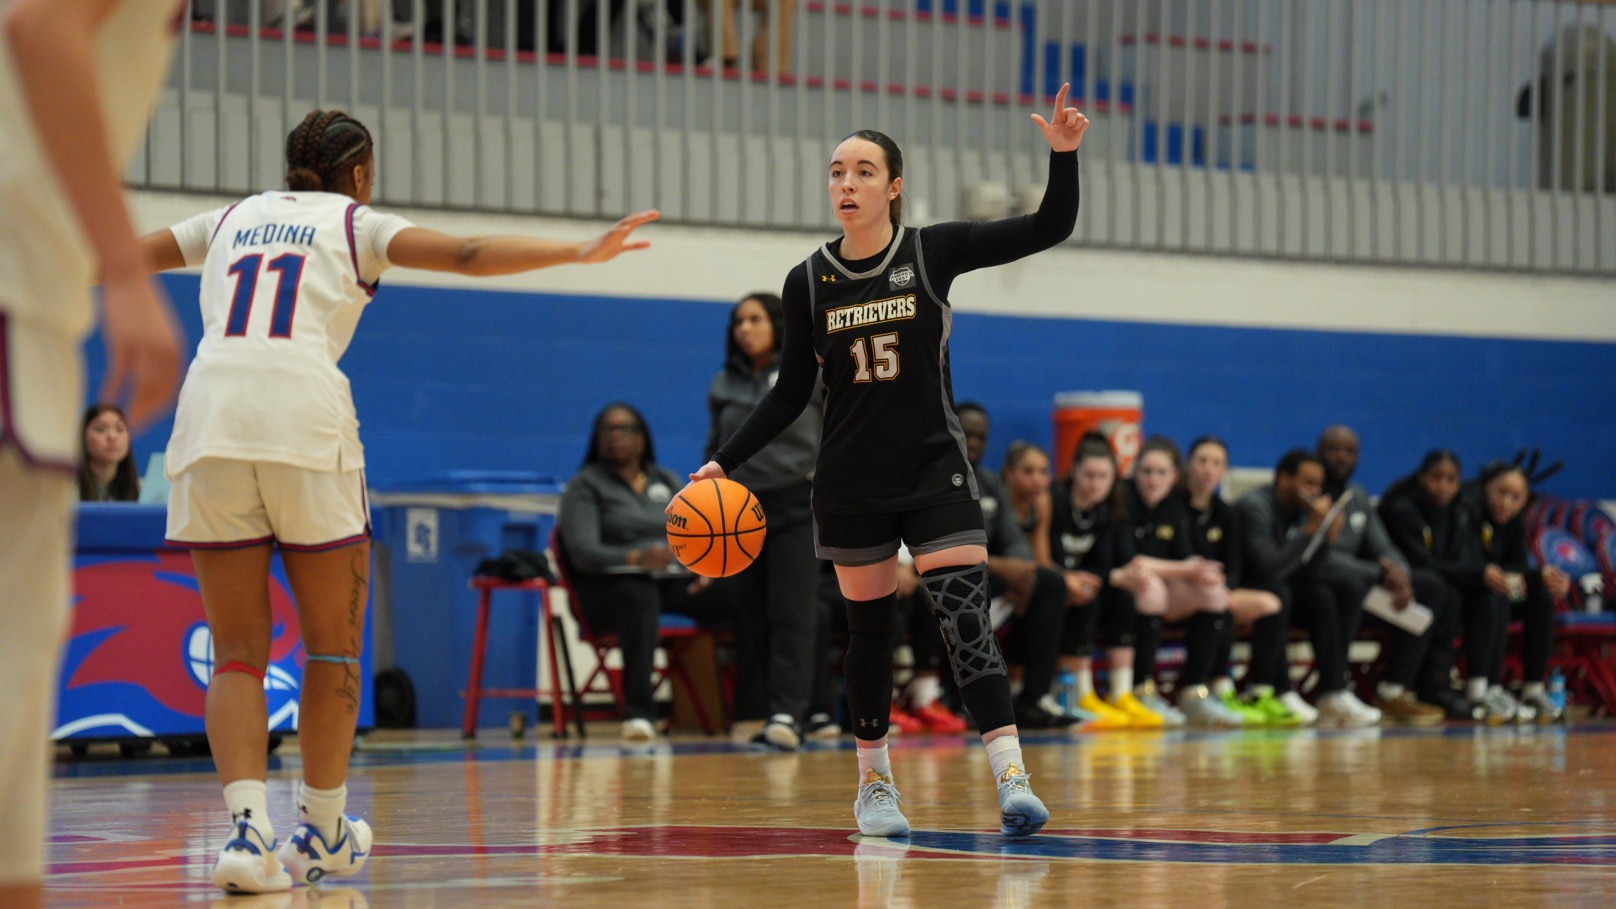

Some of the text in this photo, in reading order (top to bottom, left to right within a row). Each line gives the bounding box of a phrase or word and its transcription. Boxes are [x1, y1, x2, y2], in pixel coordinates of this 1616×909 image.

[232, 224, 316, 249] MEDINA
[224, 252, 306, 339] 11
[826, 295, 916, 333] RETRIEVERS
[850, 332, 900, 383] 15
